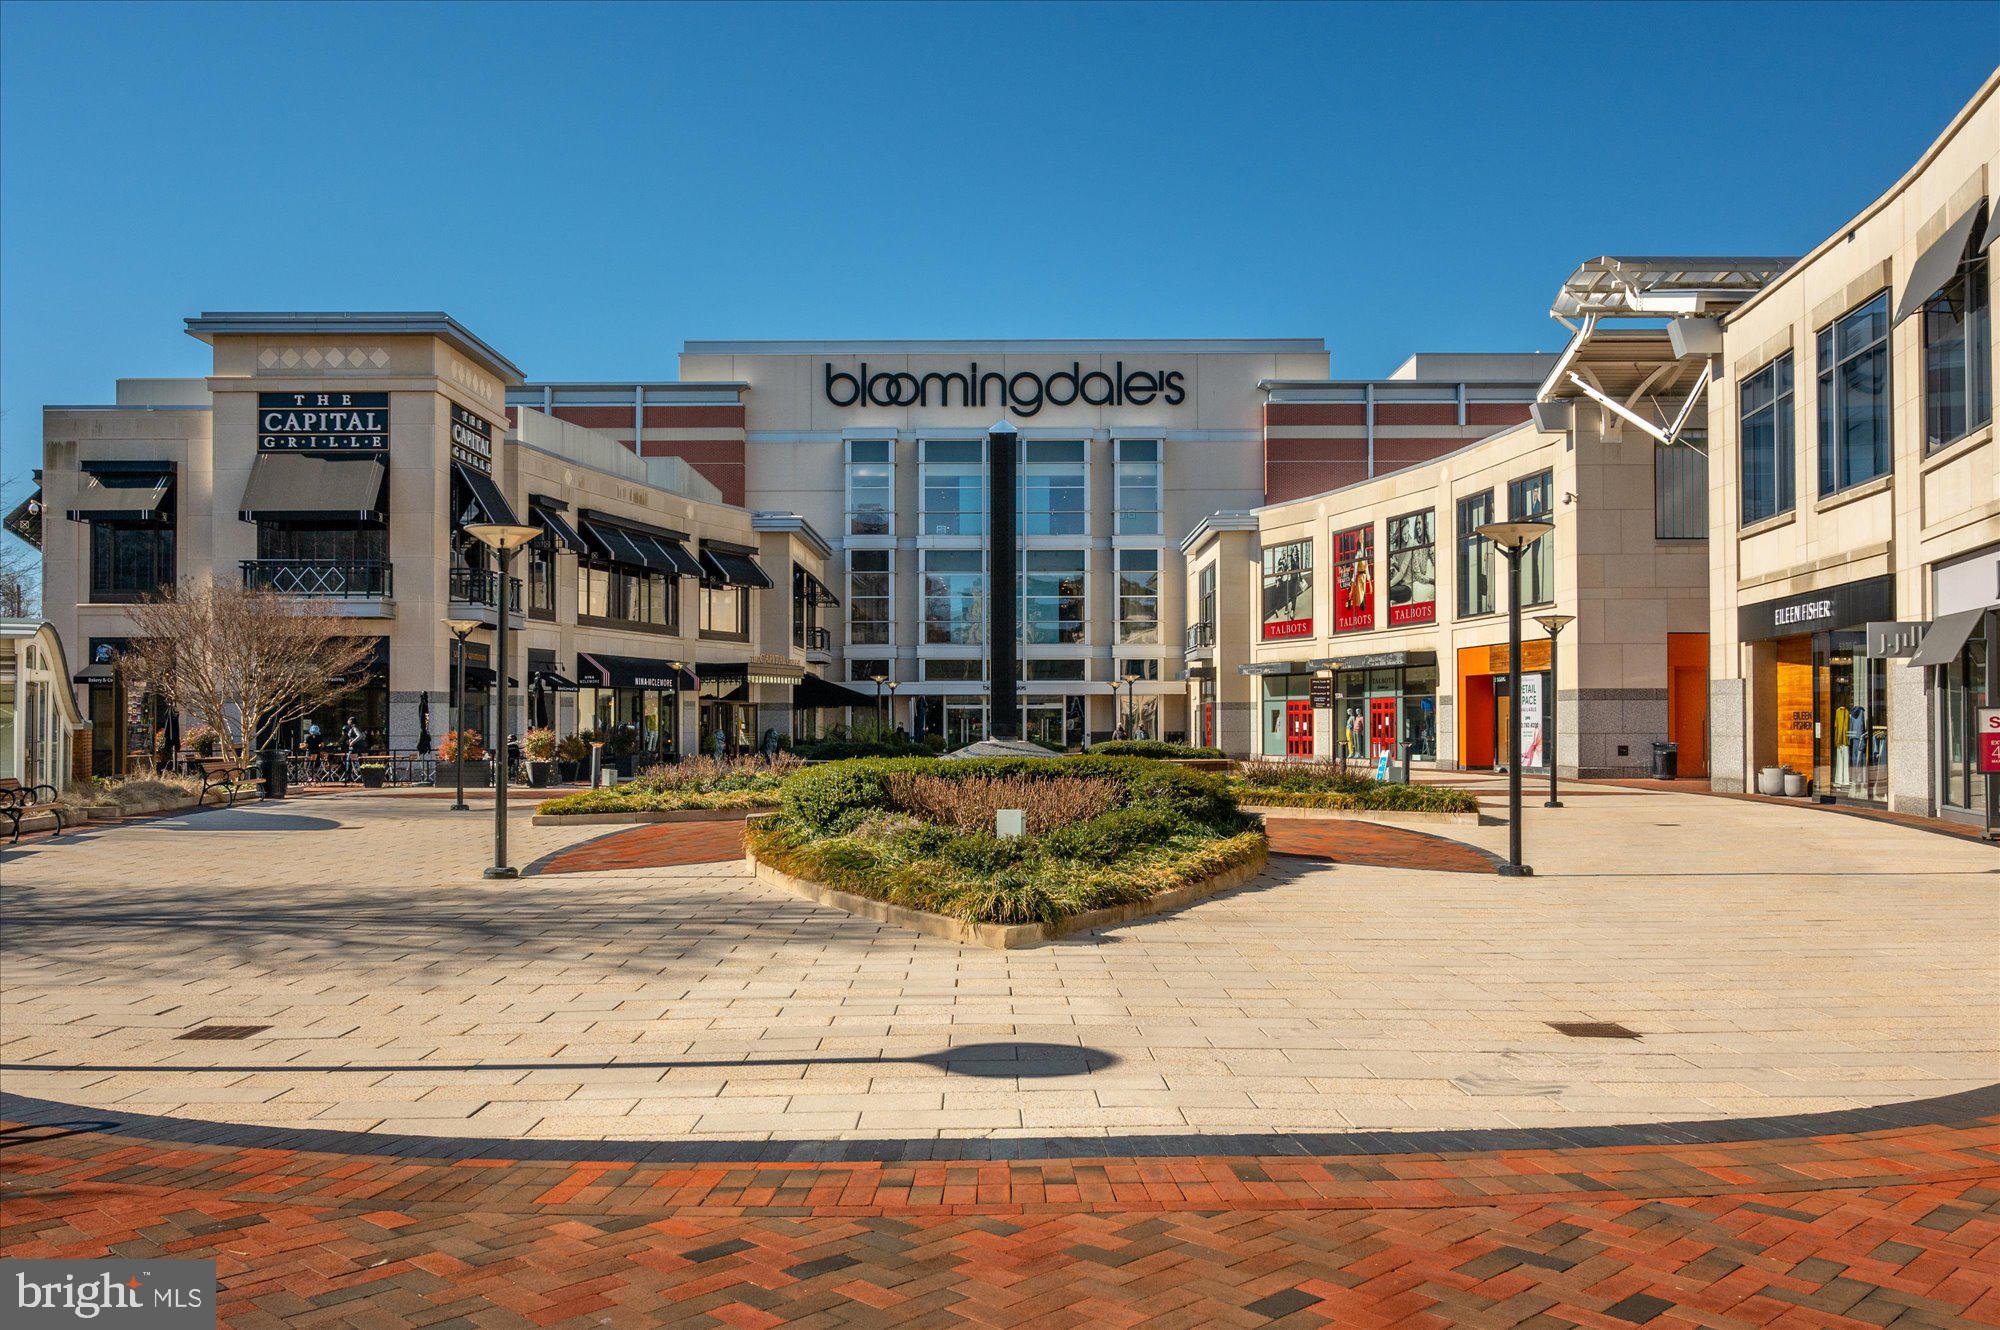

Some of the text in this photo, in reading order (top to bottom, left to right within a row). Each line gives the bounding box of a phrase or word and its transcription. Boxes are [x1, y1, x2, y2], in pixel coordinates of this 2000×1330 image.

[825, 361, 1186, 418] bloomingdale's
[294, 394, 352, 406] THE
[264, 412, 382, 431] CAPITAL
[462, 410, 483, 430] THE
[452, 424, 492, 459] CAPITAL
[1338, 614, 1373, 627] TALBOTS
[1394, 605, 1432, 621] TALBOTS
[1774, 600, 1831, 626] EILEEN FISHER
[1270, 623, 1307, 635] TALBOTS
